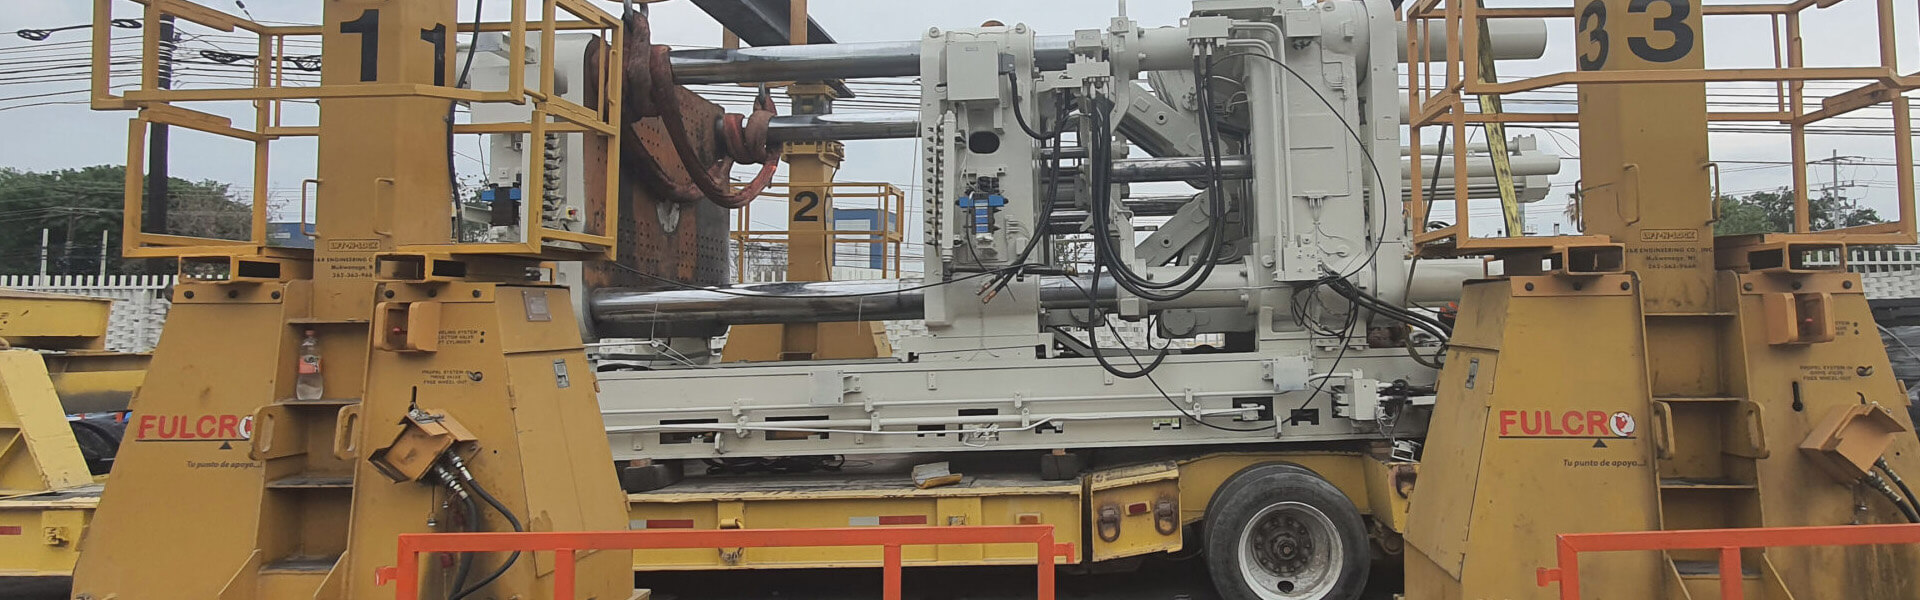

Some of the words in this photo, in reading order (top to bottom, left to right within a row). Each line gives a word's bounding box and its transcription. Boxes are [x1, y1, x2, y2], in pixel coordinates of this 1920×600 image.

[340, 9, 379, 82] 1
[421, 22, 446, 86] 1
[1579, 0, 1609, 71] 3
[1627, 0, 1694, 62] 3
[793, 191, 819, 222] 2
[1500, 410, 1635, 437] FULCRO
[196, 460, 219, 469] punto
[220, 460, 229, 468] de
[1563, 459, 1573, 467] Tu
[1574, 459, 1598, 468] punto
[1600, 459, 1610, 467] de
